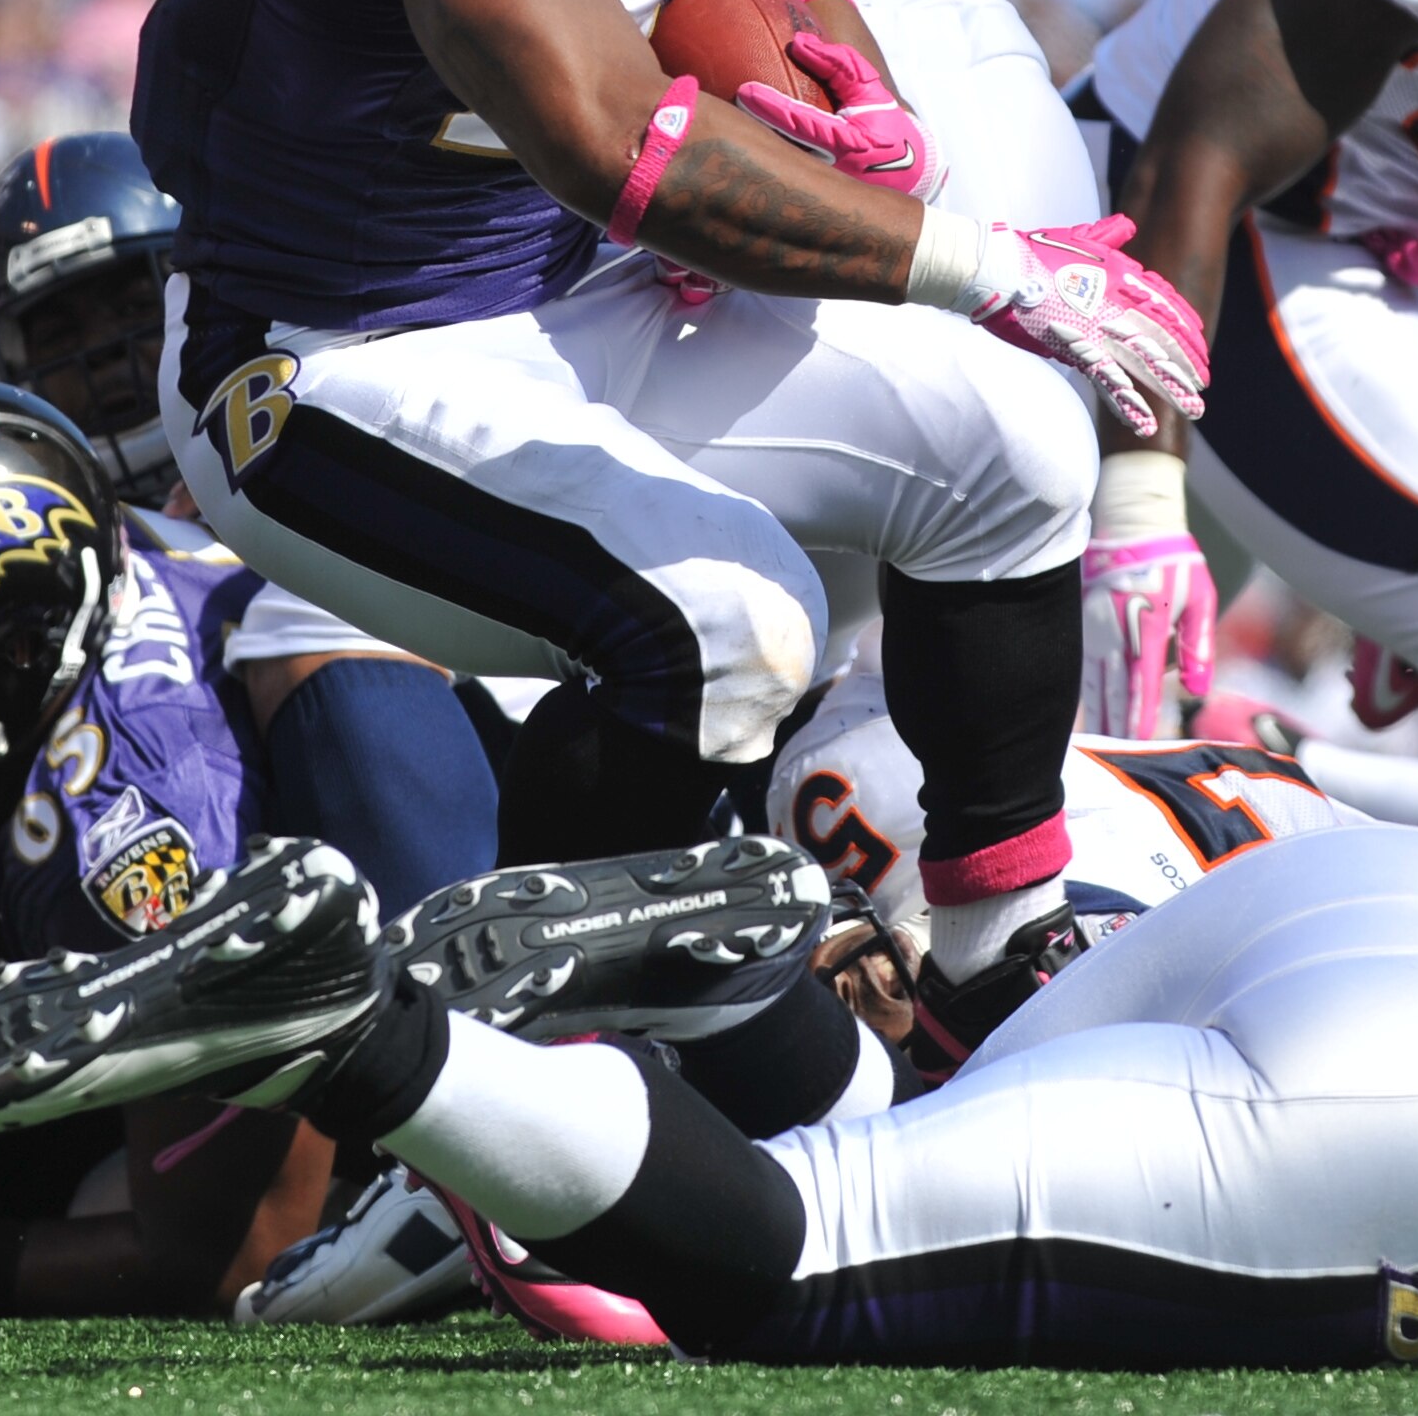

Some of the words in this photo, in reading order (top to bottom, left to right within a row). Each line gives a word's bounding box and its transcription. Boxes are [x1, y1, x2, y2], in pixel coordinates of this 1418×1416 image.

[194, 350, 299, 482] B
[95, 829, 173, 889] RAVENS
[774, 768, 902, 897] 5
[175, 900, 251, 951] UNDER
[541, 911, 623, 941] UNDER
[627, 889, 728, 925] ARMOUR
[77, 943, 175, 998] ARMOUR
